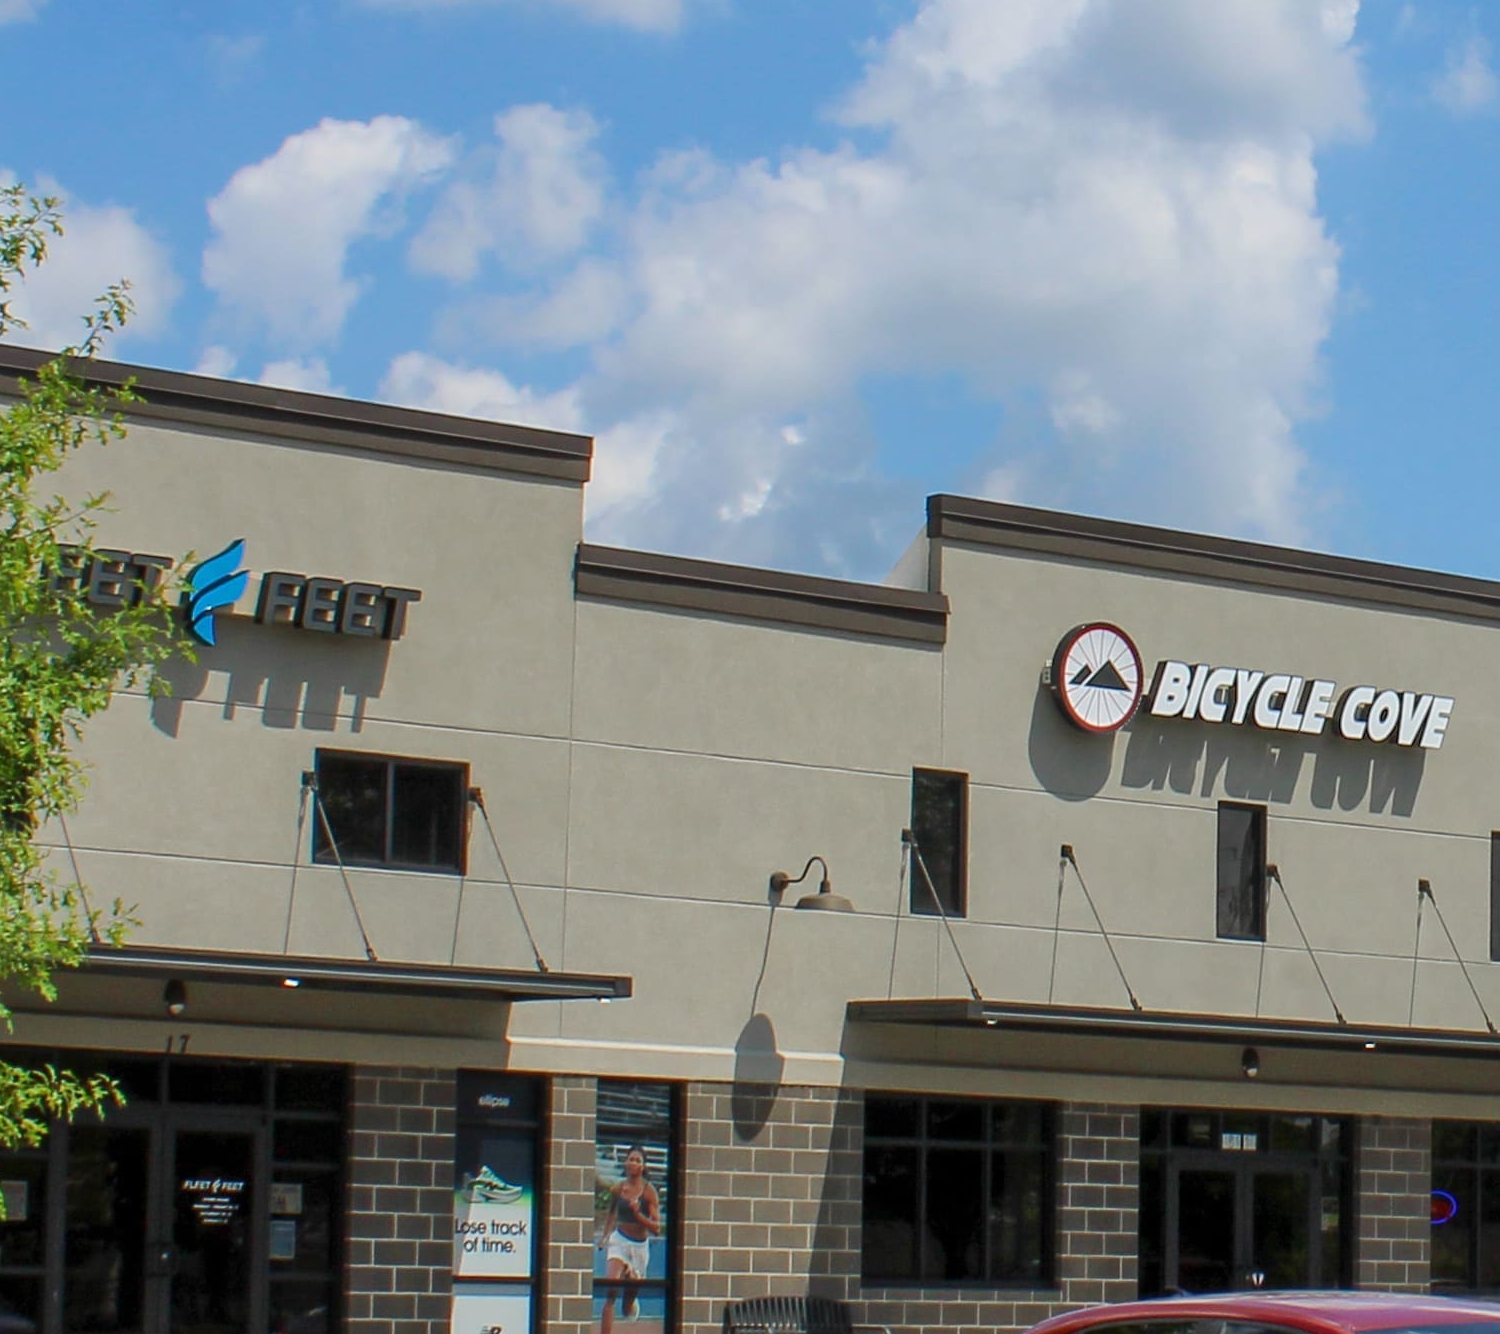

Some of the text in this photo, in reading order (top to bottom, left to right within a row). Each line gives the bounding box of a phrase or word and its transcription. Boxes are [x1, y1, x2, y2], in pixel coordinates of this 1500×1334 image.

[257, 571, 422, 640] FEET
[1141, 659, 1455, 750] BICYCLE COVE
[455, 1219, 527, 1236] Lose track
[464, 1238, 517, 1254] of time.
